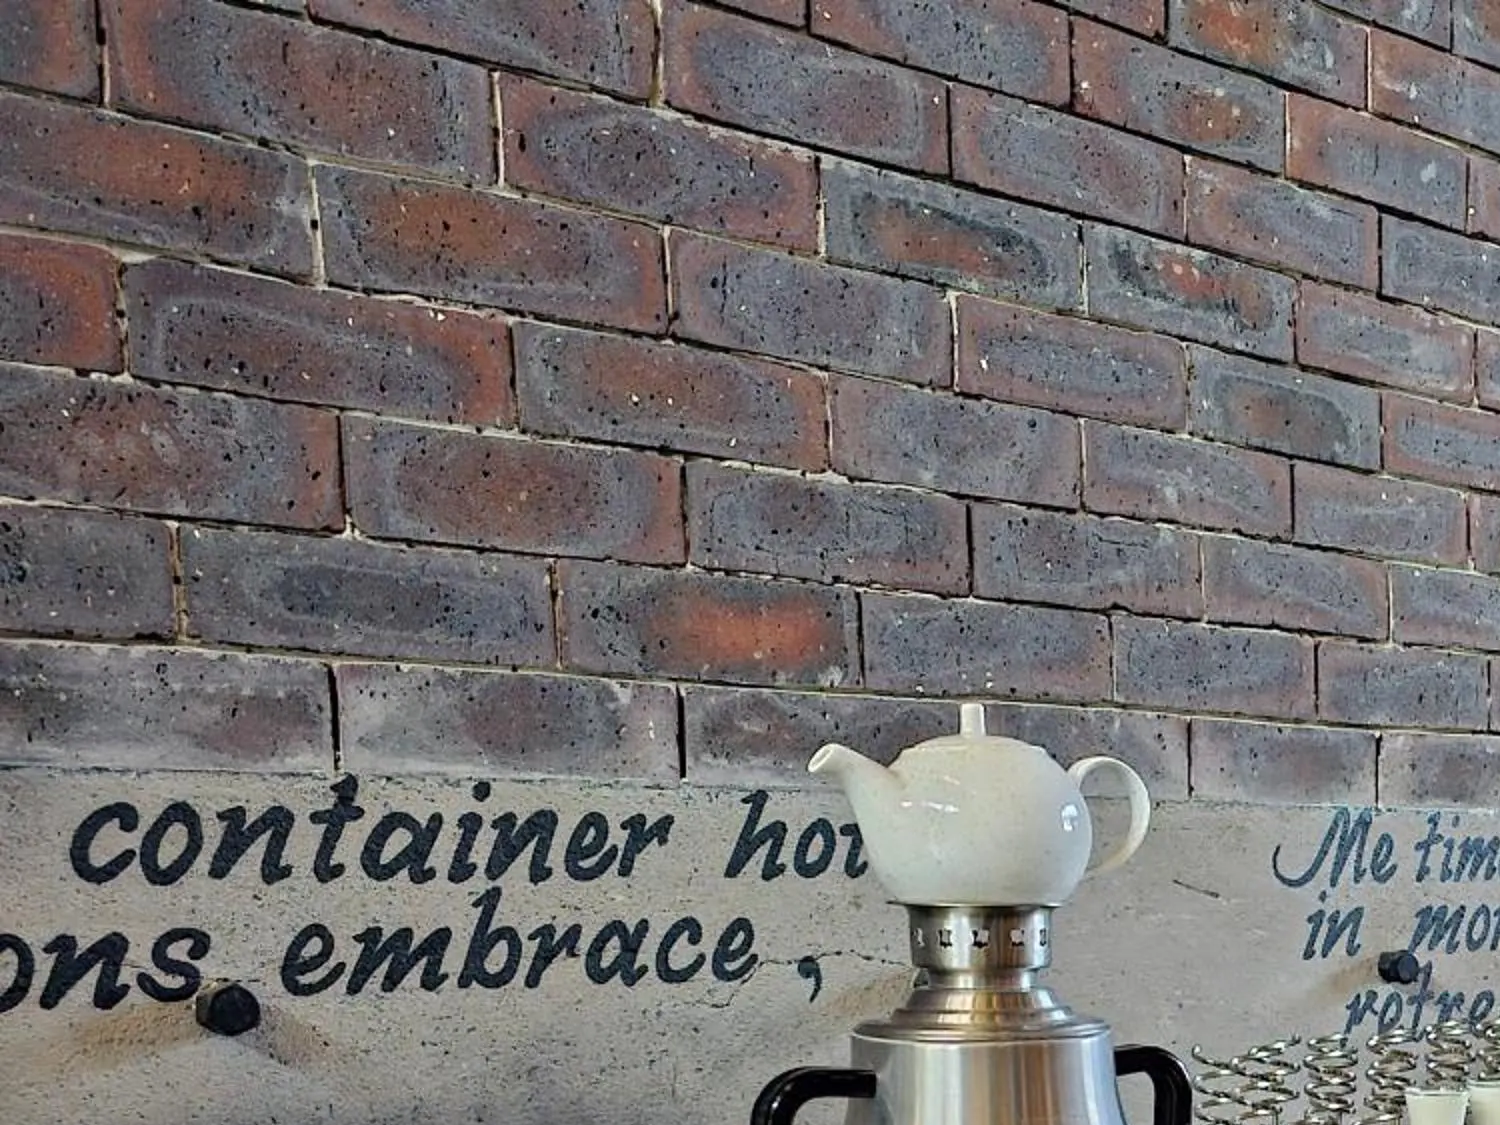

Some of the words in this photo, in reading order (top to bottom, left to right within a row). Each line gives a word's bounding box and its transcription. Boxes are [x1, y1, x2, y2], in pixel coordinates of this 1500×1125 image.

[70, 774, 675, 886] container
[724, 789, 868, 881] hot
[1272, 807, 1397, 888] Me
[1303, 890, 1365, 960] in
